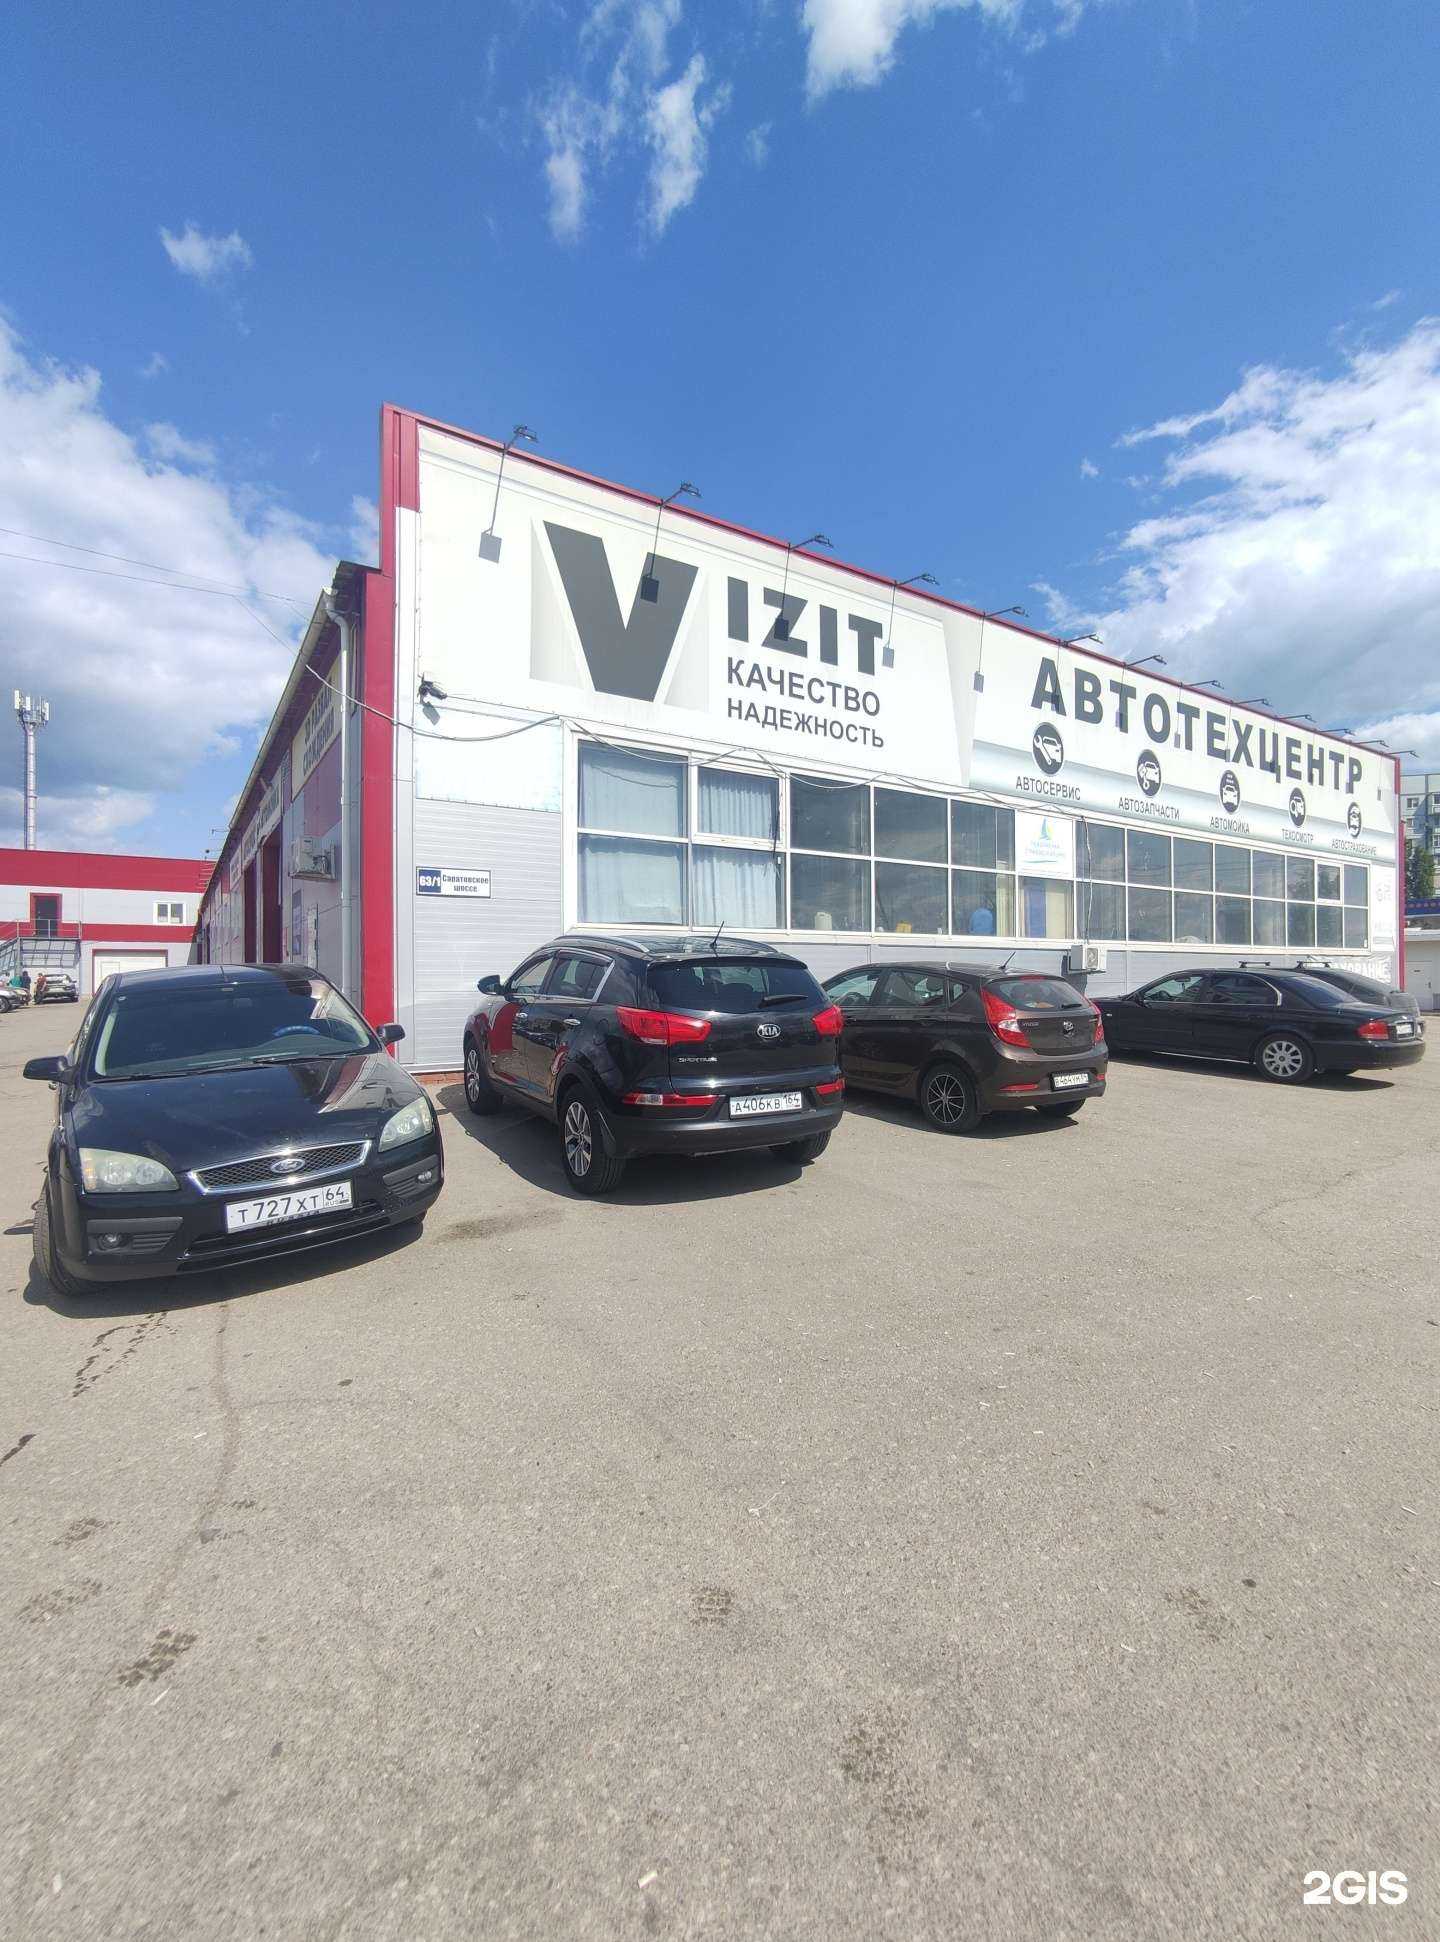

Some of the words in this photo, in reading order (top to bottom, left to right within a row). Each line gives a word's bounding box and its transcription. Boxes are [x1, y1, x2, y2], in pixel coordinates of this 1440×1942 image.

[543, 520, 883, 702] VIZIT
[728, 657, 881, 716] КАЧЕСТВО
[728, 698, 884, 748] НАДЕЖНОСТЬ
[1031, 657, 1362, 793] АВТОТЕХЦЕНТР
[1016, 776, 1081, 801] АВТОСЕРВИС
[1118, 797, 1180, 820] АВТОЗАПЧАСТИ
[1281, 829, 1314, 845] ТЕХОСМОТР
[1331, 838, 1377, 856] АВТОСТРАХОВАНИЕ
[761, 1026, 778, 1036] KIA
[326, 1186, 344, 1200] 64
